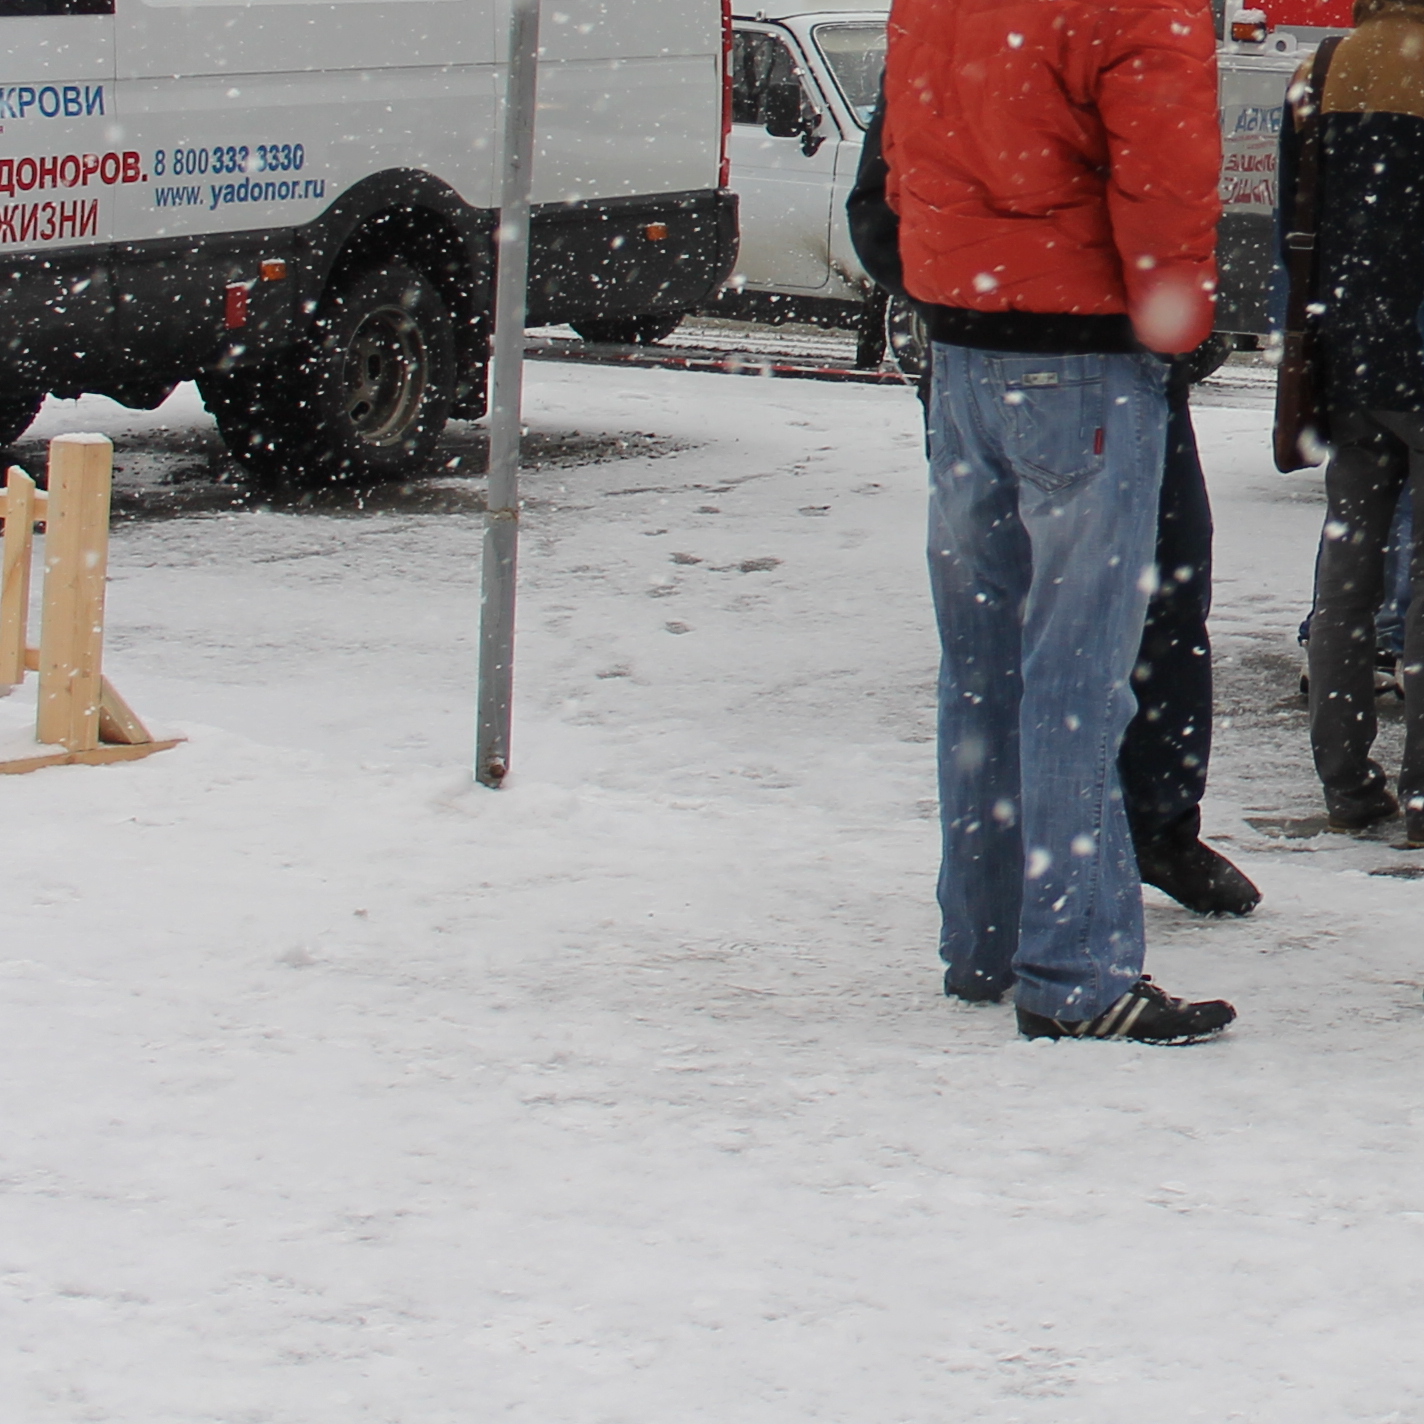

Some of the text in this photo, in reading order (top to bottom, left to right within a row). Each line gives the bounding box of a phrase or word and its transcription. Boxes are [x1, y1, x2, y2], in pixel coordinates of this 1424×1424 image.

[0, 85, 105, 119] КРОВИ
[154, 149, 165, 176] 8
[173, 147, 208, 176] 800
[155, 177, 326, 211] www. yadonor.ru
